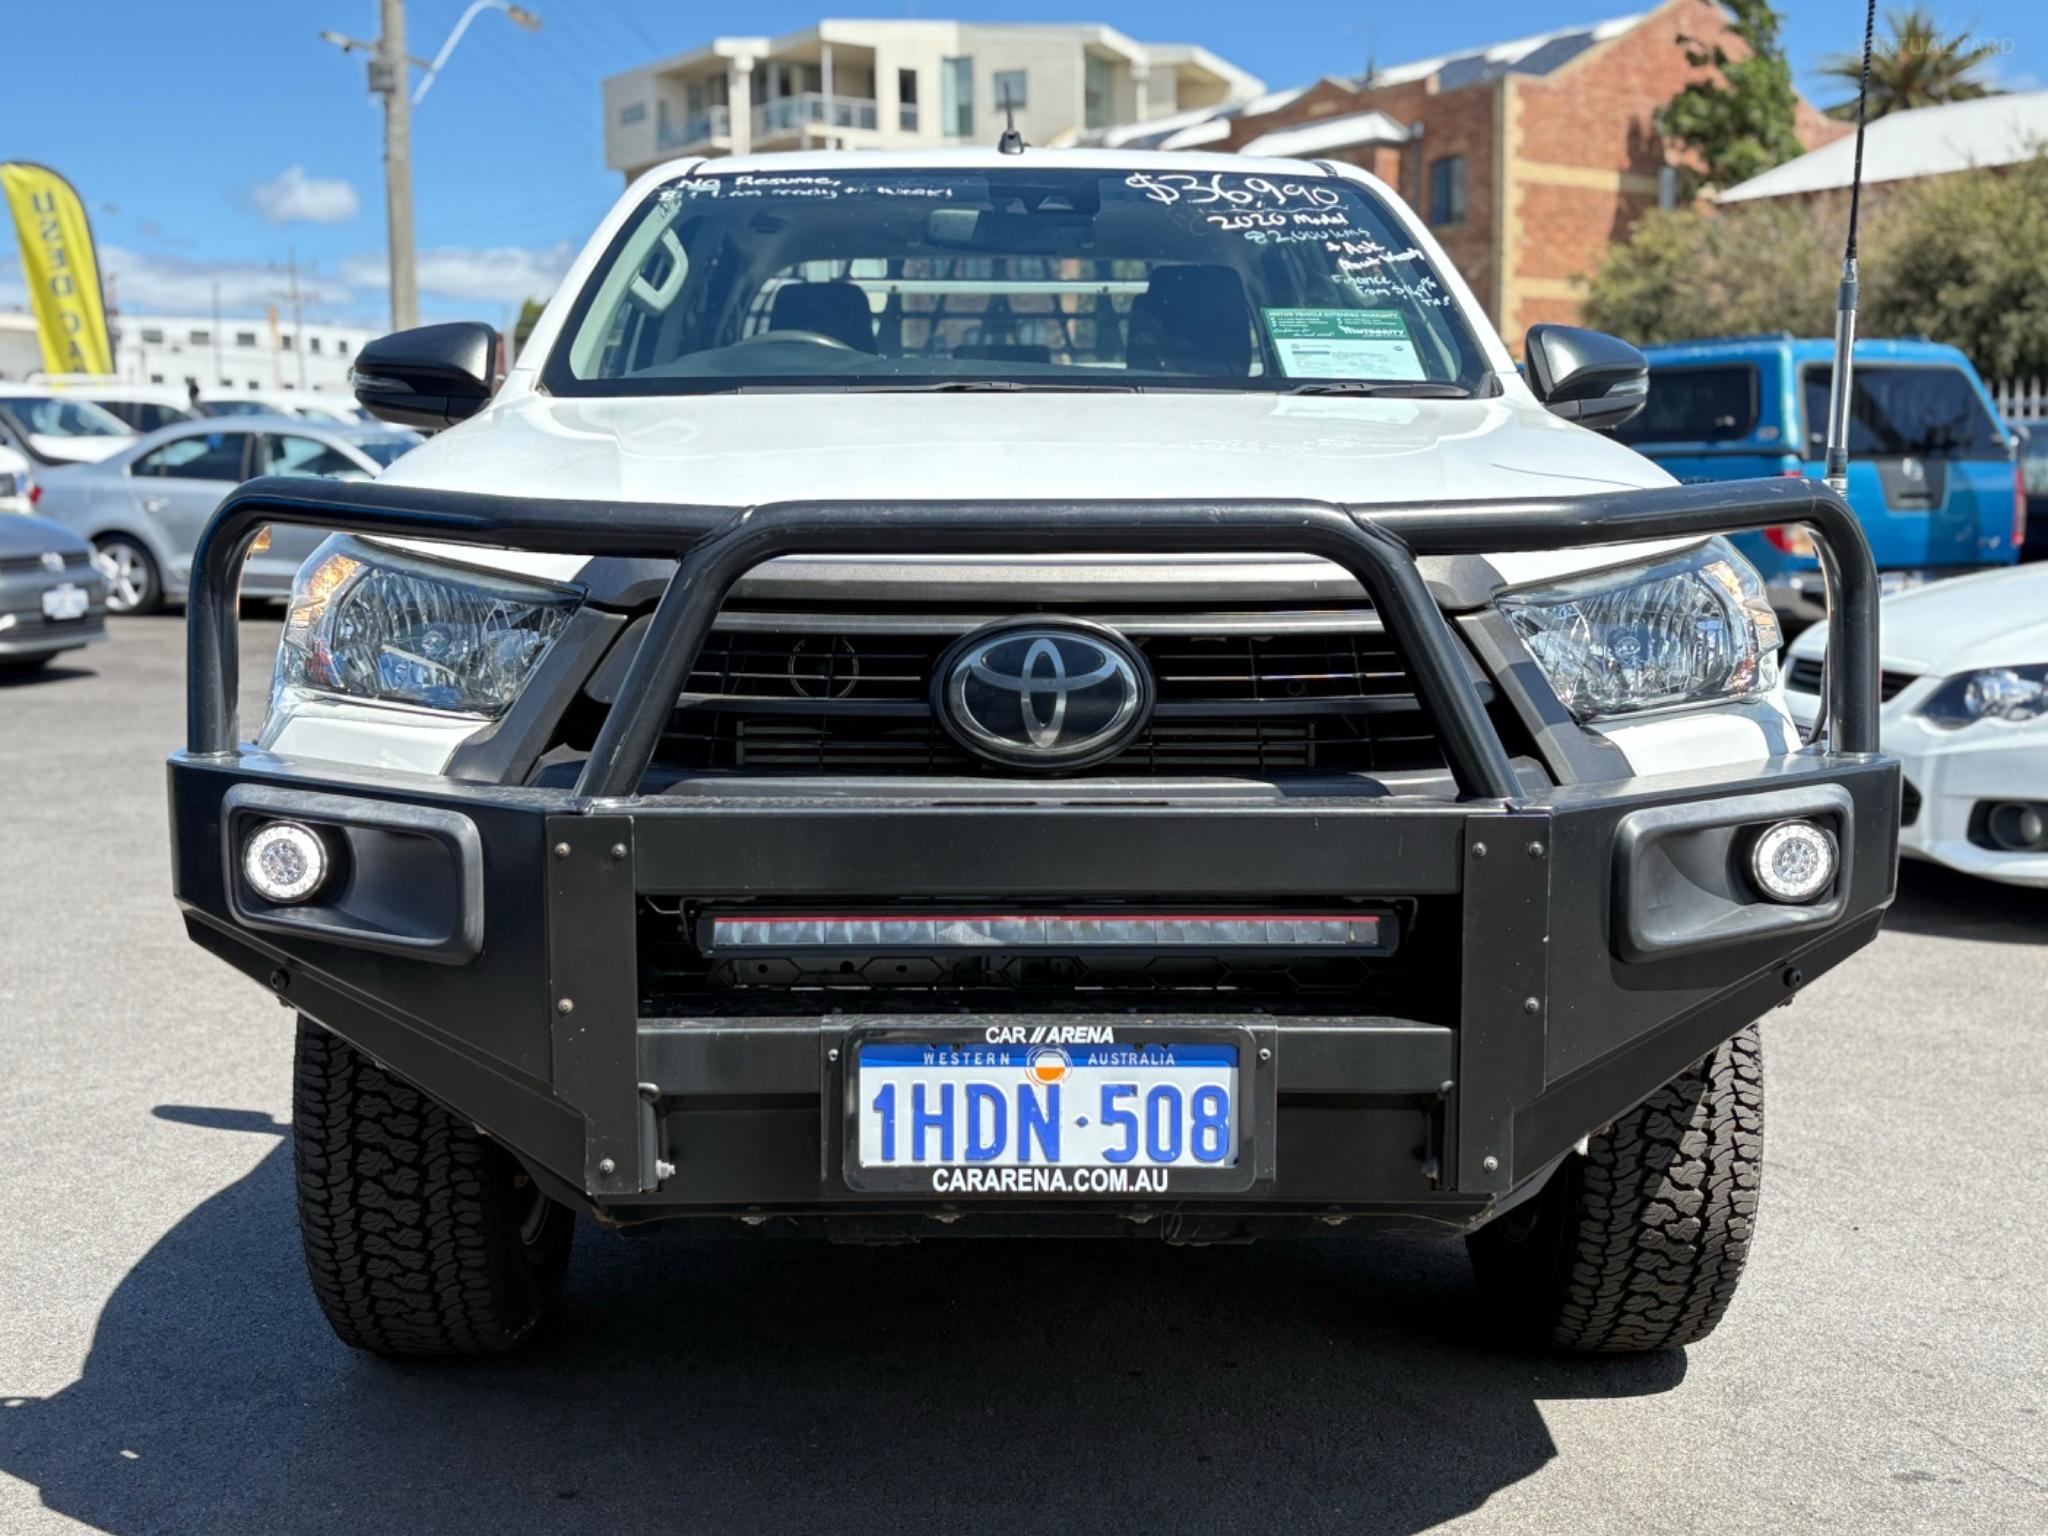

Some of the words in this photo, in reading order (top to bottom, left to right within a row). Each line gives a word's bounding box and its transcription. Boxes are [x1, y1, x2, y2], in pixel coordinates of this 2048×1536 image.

[1125, 172, 1339, 208] $36,990
[1207, 213, 1286, 230] 2020
[923, 1053, 1011, 1066] WESTERN
[1088, 1053, 1176, 1066] AUSTRALIA
[932, 1168, 1169, 1192] CARARENA.COM.AU
